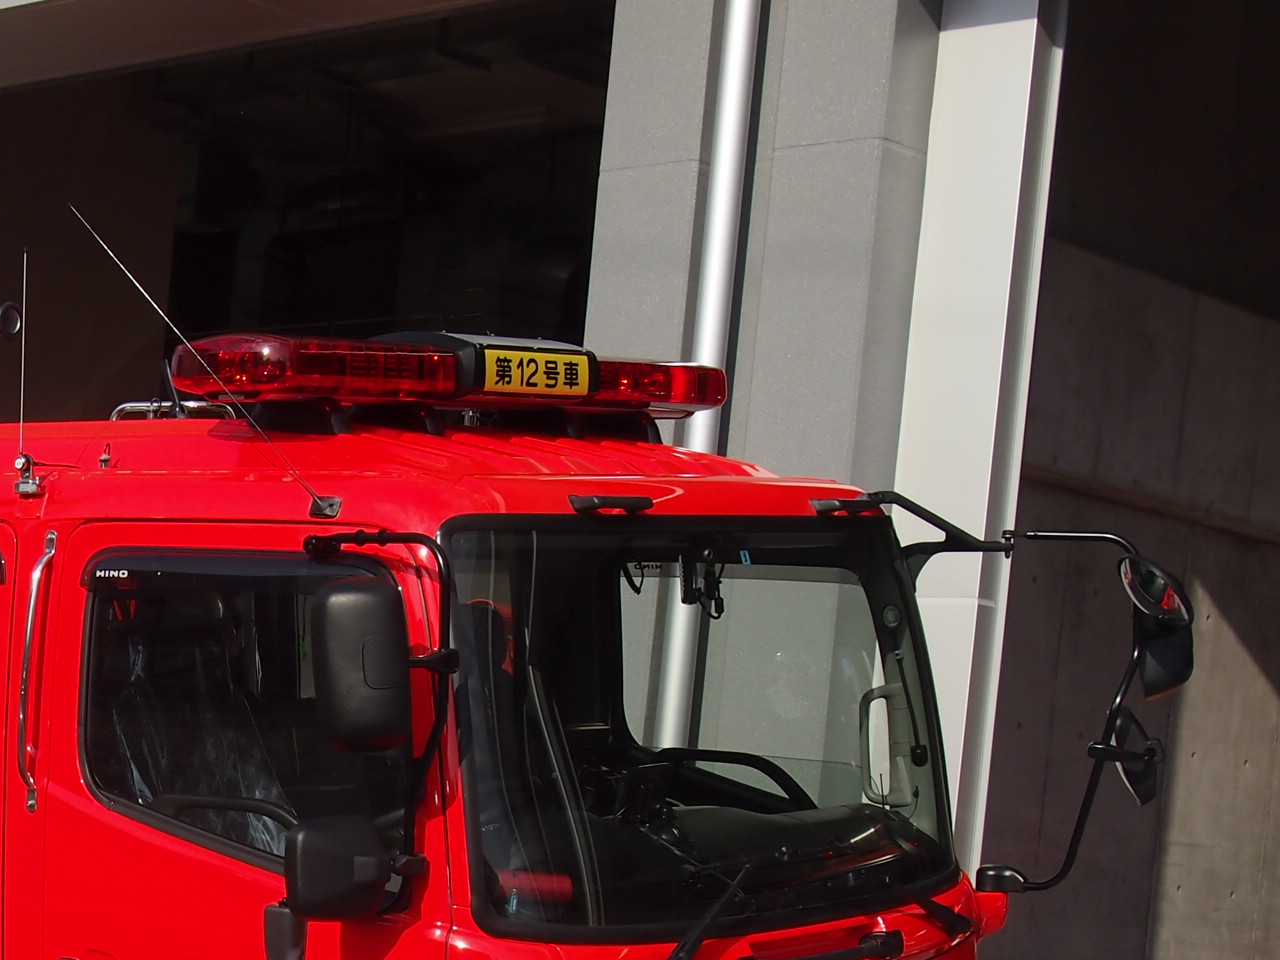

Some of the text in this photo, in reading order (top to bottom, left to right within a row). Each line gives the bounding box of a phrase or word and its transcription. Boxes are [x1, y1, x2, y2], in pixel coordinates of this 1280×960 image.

[494, 355, 580, 390] 第12号車
[95, 569, 129, 578] HINO
